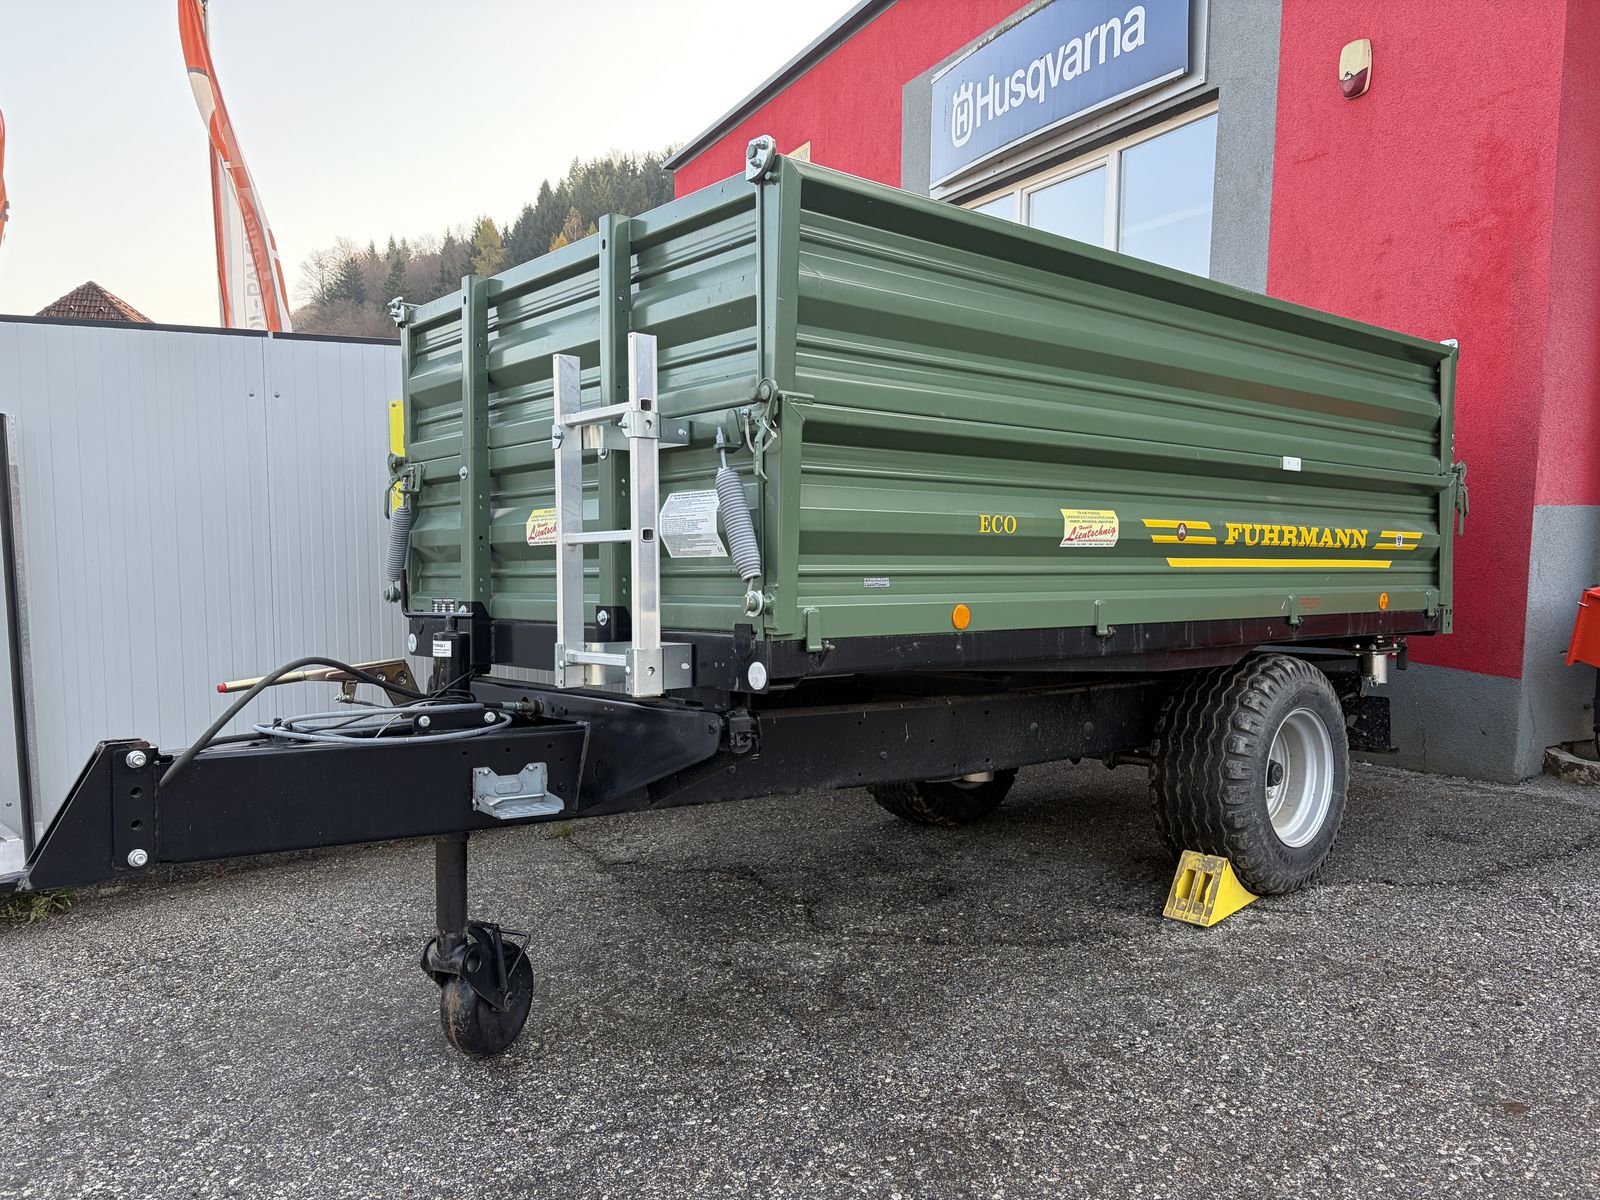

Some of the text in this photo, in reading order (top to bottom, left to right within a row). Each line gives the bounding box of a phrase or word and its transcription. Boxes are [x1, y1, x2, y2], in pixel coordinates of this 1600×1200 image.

[975, 5, 1146, 128] Husqvarna
[979, 514, 1018, 535] ECO
[1063, 524, 1117, 542] Lientschnig
[1224, 522, 1368, 549] FUHRMANN
